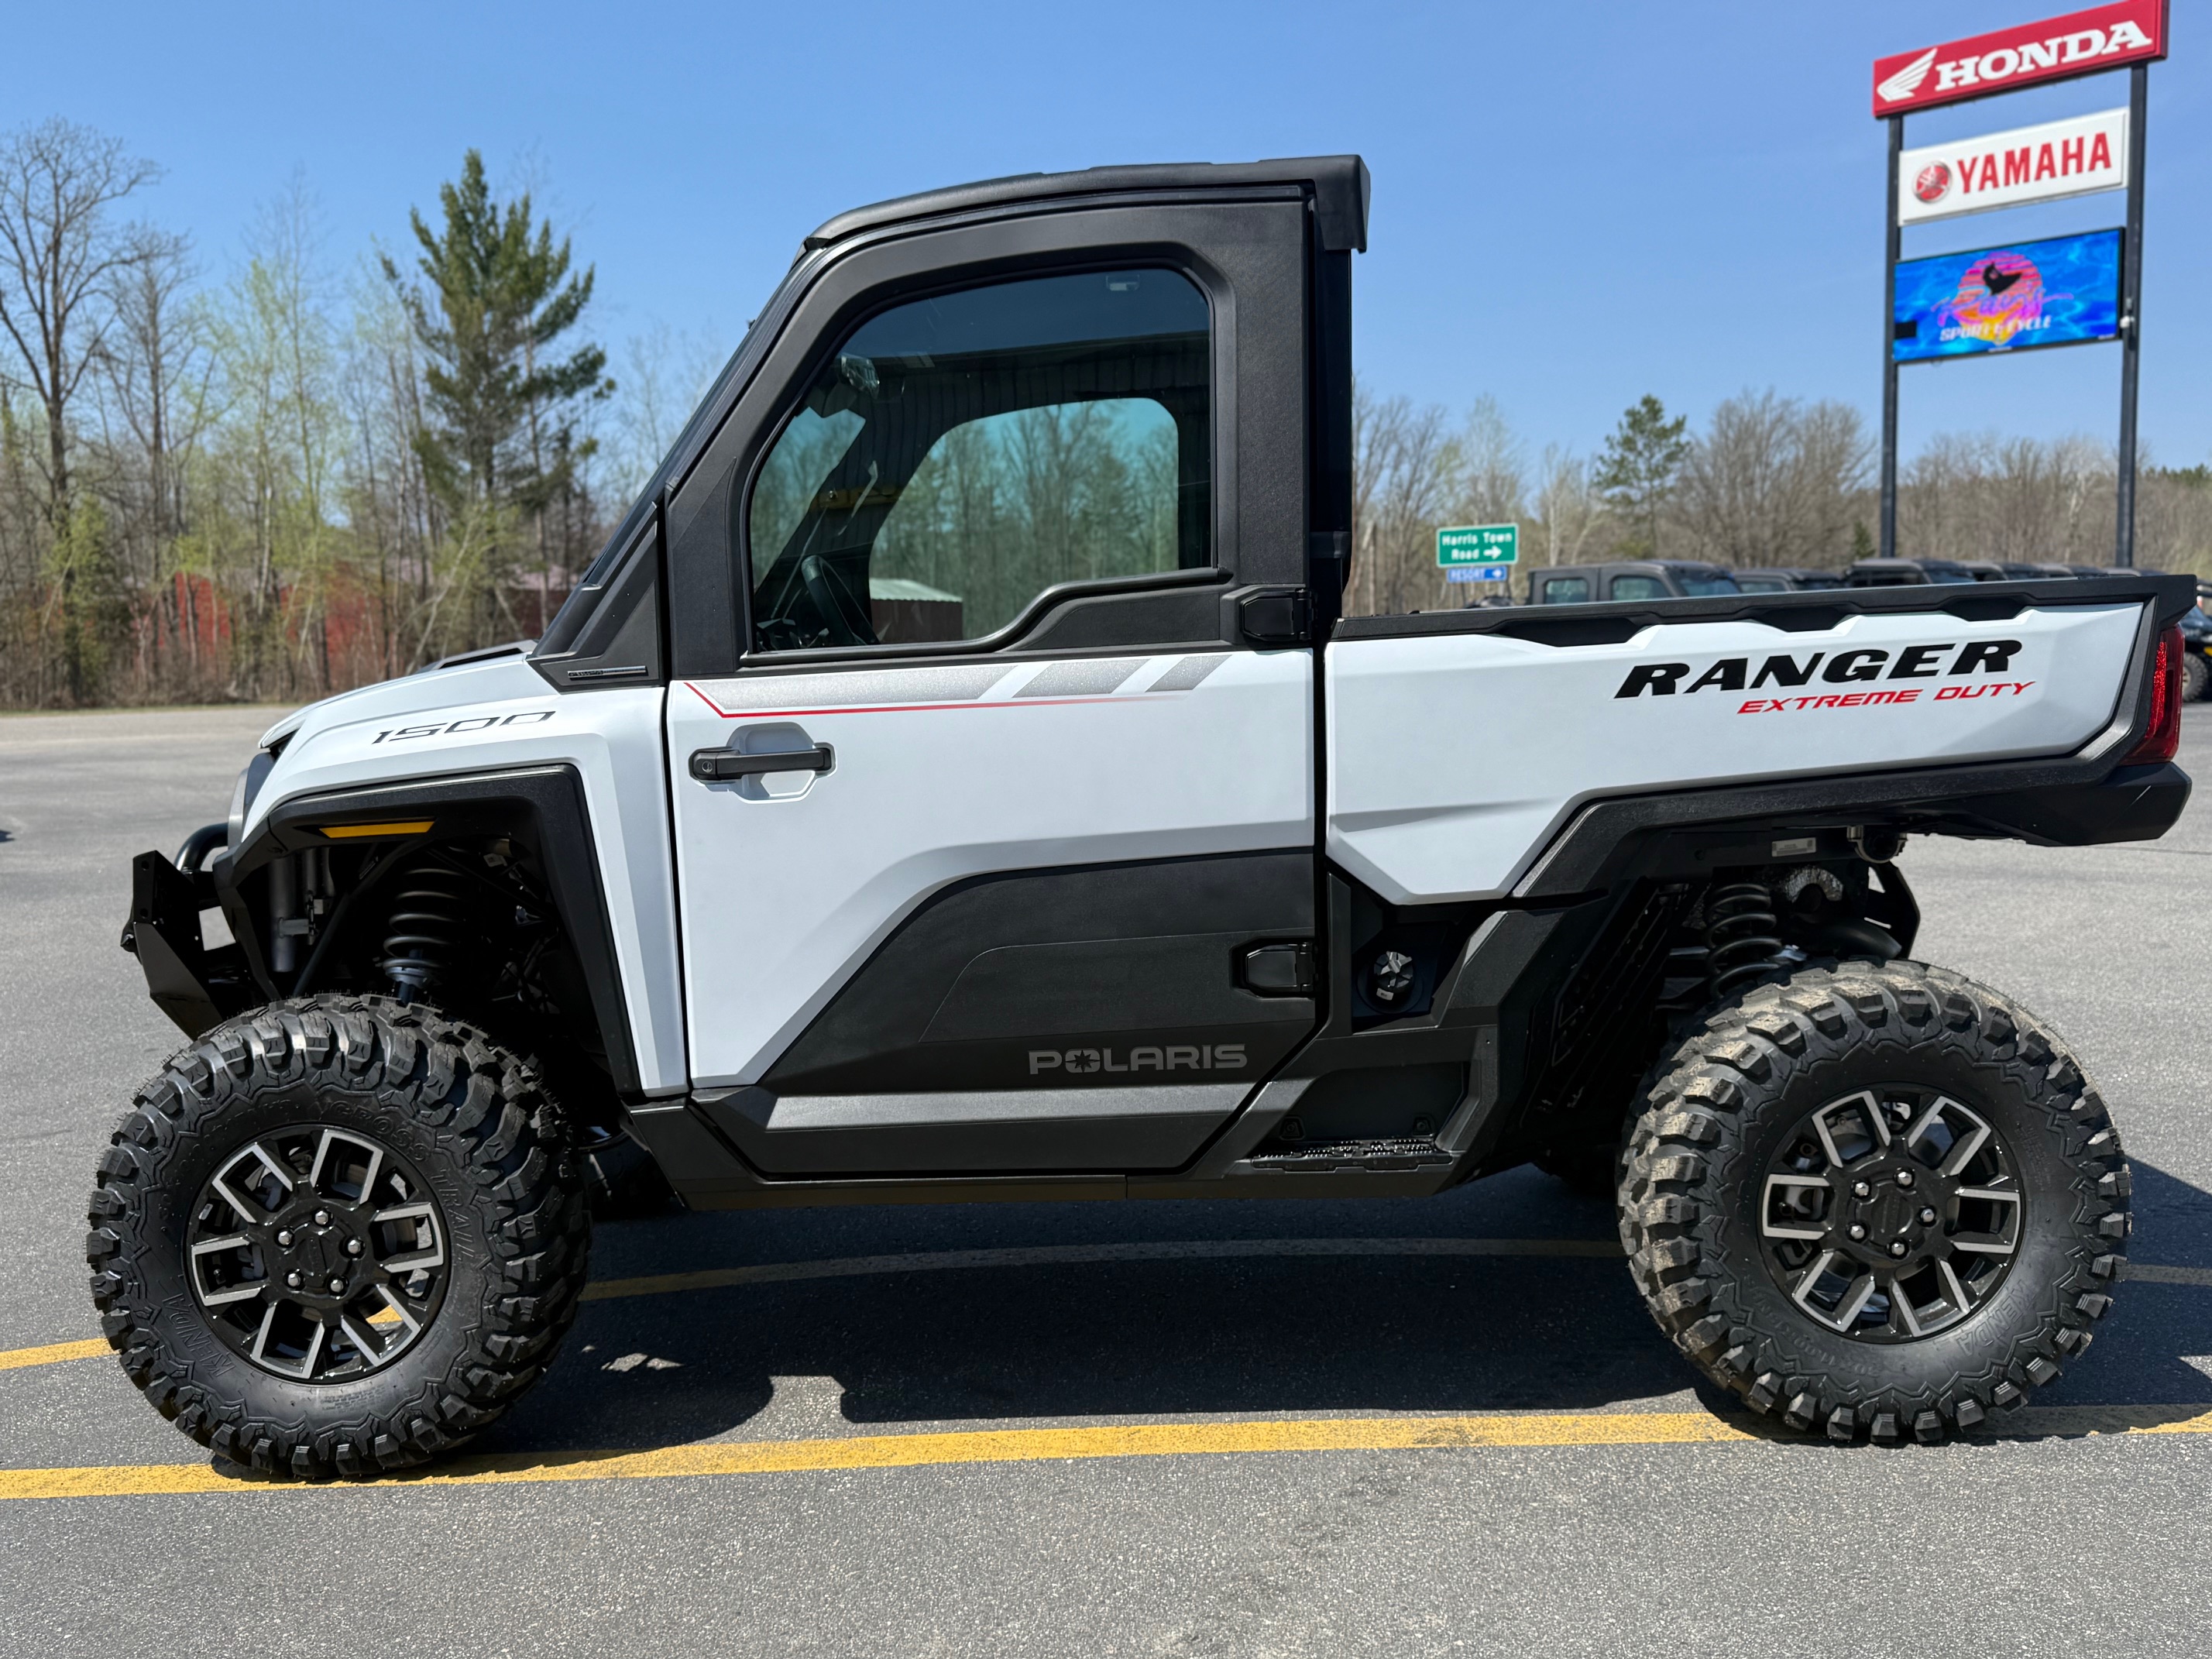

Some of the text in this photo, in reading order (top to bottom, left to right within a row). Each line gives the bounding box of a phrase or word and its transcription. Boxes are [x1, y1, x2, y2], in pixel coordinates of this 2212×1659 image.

[1935, 20, 2152, 91] HONDA
[1957, 132, 2111, 194] YAMAHA
[1442, 531, 1513, 546] Harris Town
[1451, 548, 1479, 561] Road
[1613, 640, 2023, 699] RANGER
[1737, 681, 2036, 714] EXTREME DUTY
[371, 711, 556, 744] 1500
[1028, 1044, 1248, 1075] POLARIS
[161, 1293, 235, 1378] KENDA
[1956, 1279, 2037, 1357] KENDA
